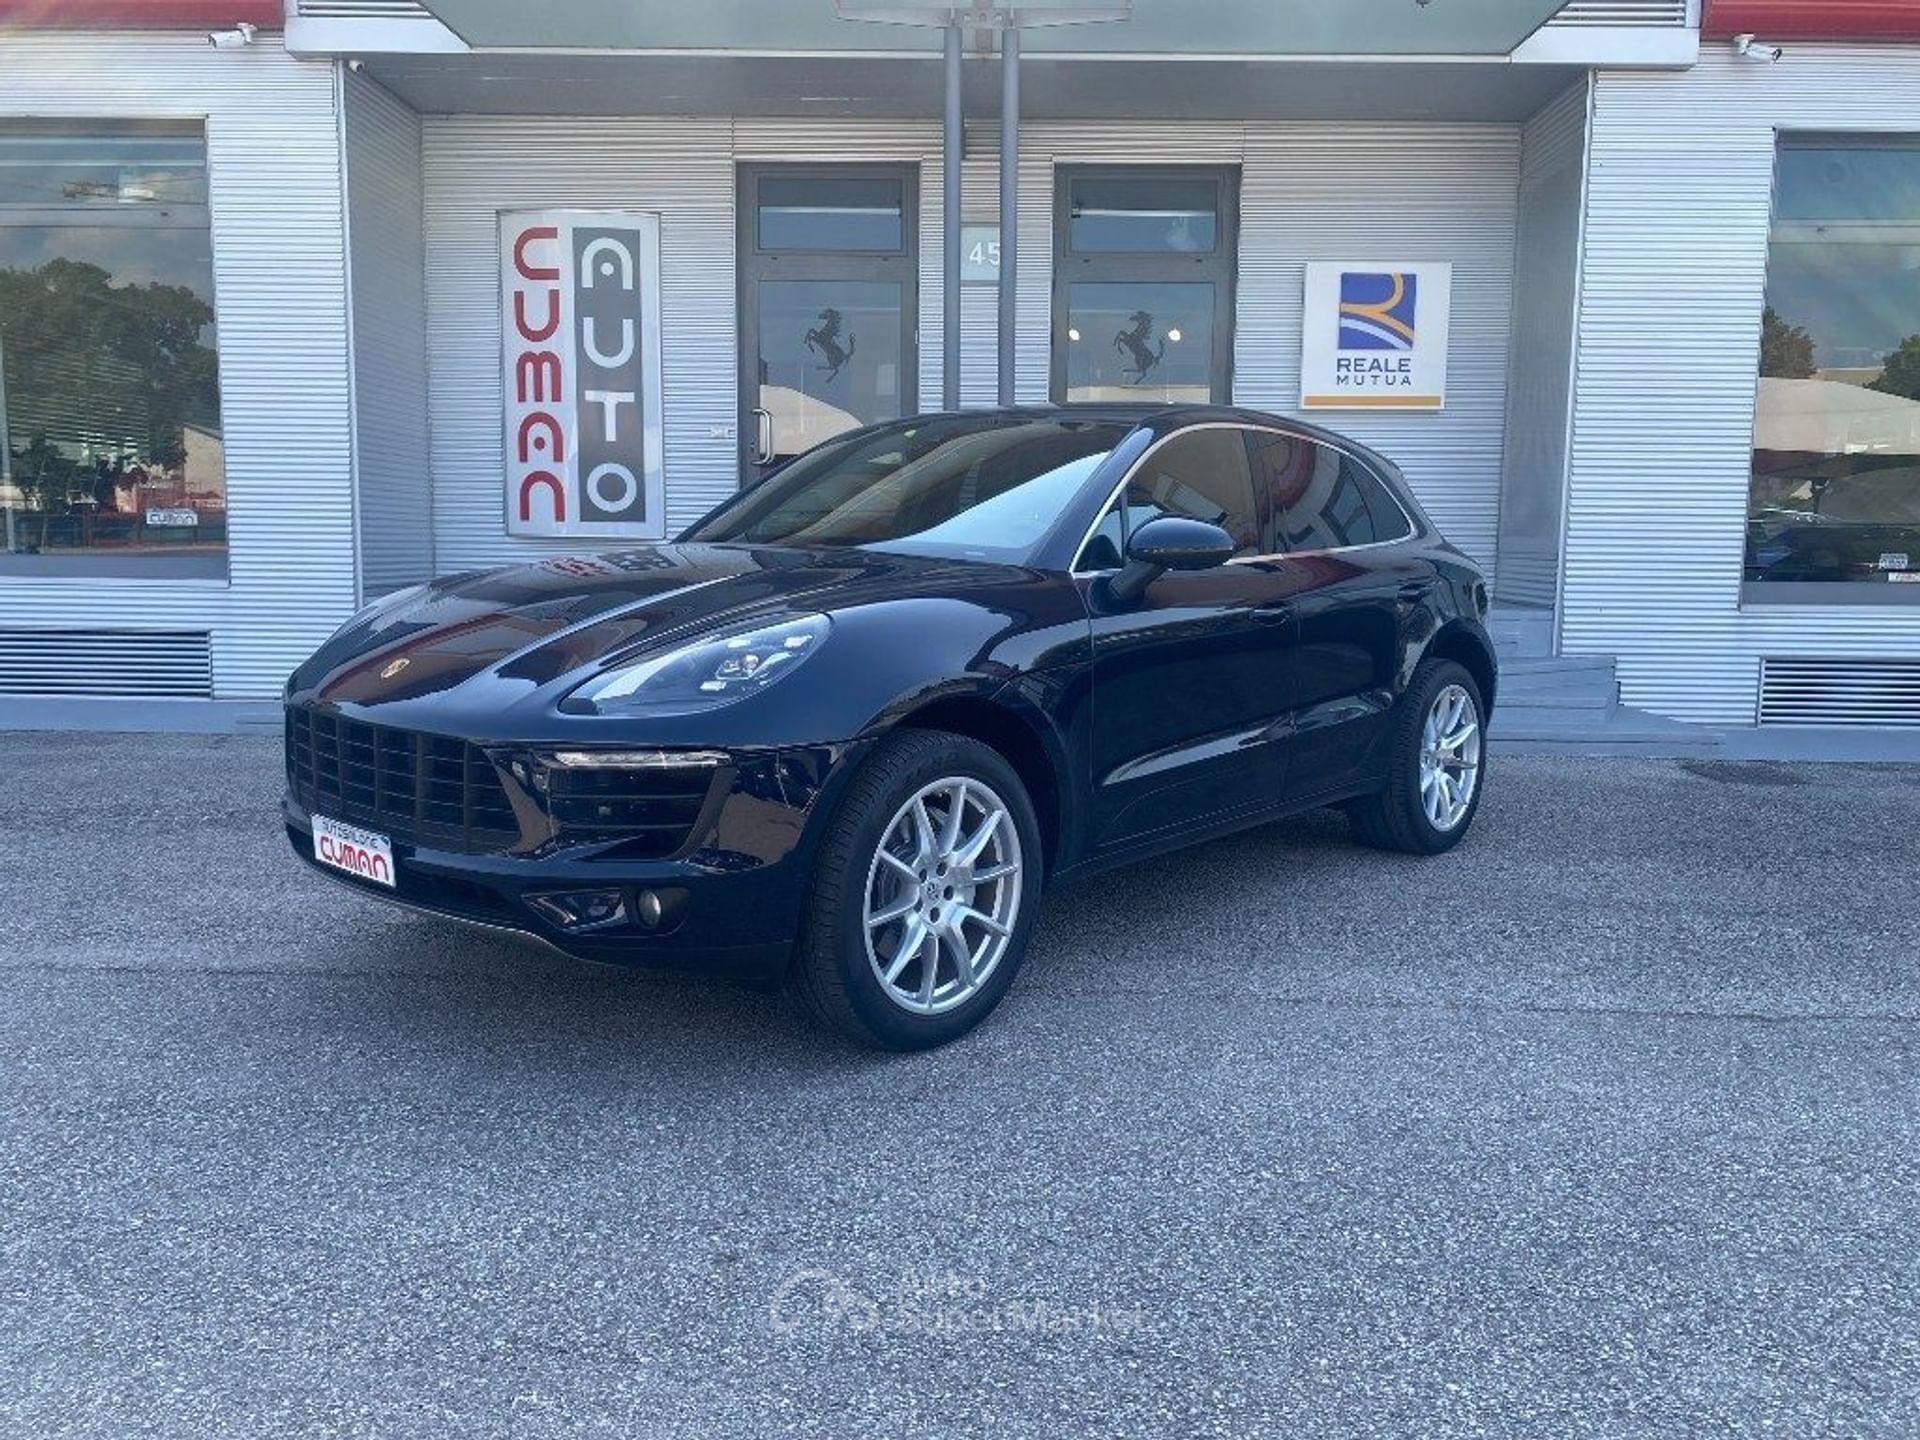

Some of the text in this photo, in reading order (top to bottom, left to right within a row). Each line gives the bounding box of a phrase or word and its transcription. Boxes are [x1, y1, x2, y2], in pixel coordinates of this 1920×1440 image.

[969, 241, 1000, 265] 45
[514, 227, 566, 522] CUMAN
[581, 237, 637, 513] AUTO
[1336, 358, 1411, 373] REALE
[1336, 375, 1412, 386] MUTUA
[320, 836, 389, 882] CUMAN
